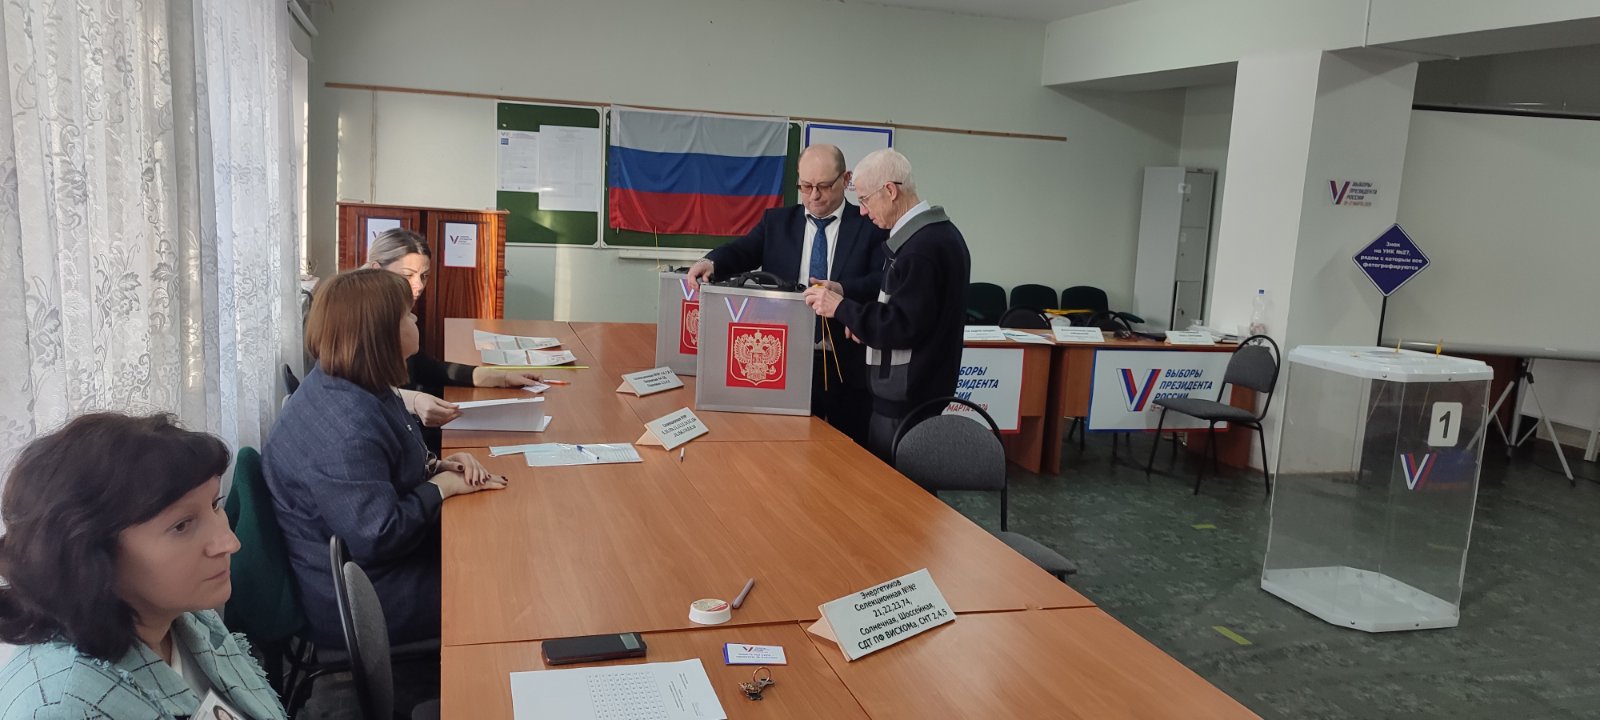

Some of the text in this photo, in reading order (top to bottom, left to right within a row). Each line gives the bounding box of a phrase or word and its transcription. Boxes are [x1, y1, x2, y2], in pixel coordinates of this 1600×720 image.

[959, 366, 988, 376] БОРЫ
[1165, 369, 1203, 378] ВЫБОРЫ
[956, 379, 999, 390] ЗИДЕНТА
[1159, 381, 1213, 391] ПРЕЗИДЕНТА
[1439, 410, 1451, 439] 1
[860, 580, 902, 600] Энергетиков
[854, 591, 902, 612] Селекционная
[873, 598, 913, 618] 21,22,23,74,
[857, 608, 948, 650] СДТ ПФ ВИСХОМа, СНТ 2,4,5
[859, 602, 936, 636] Солнечная, Шоссейная,
